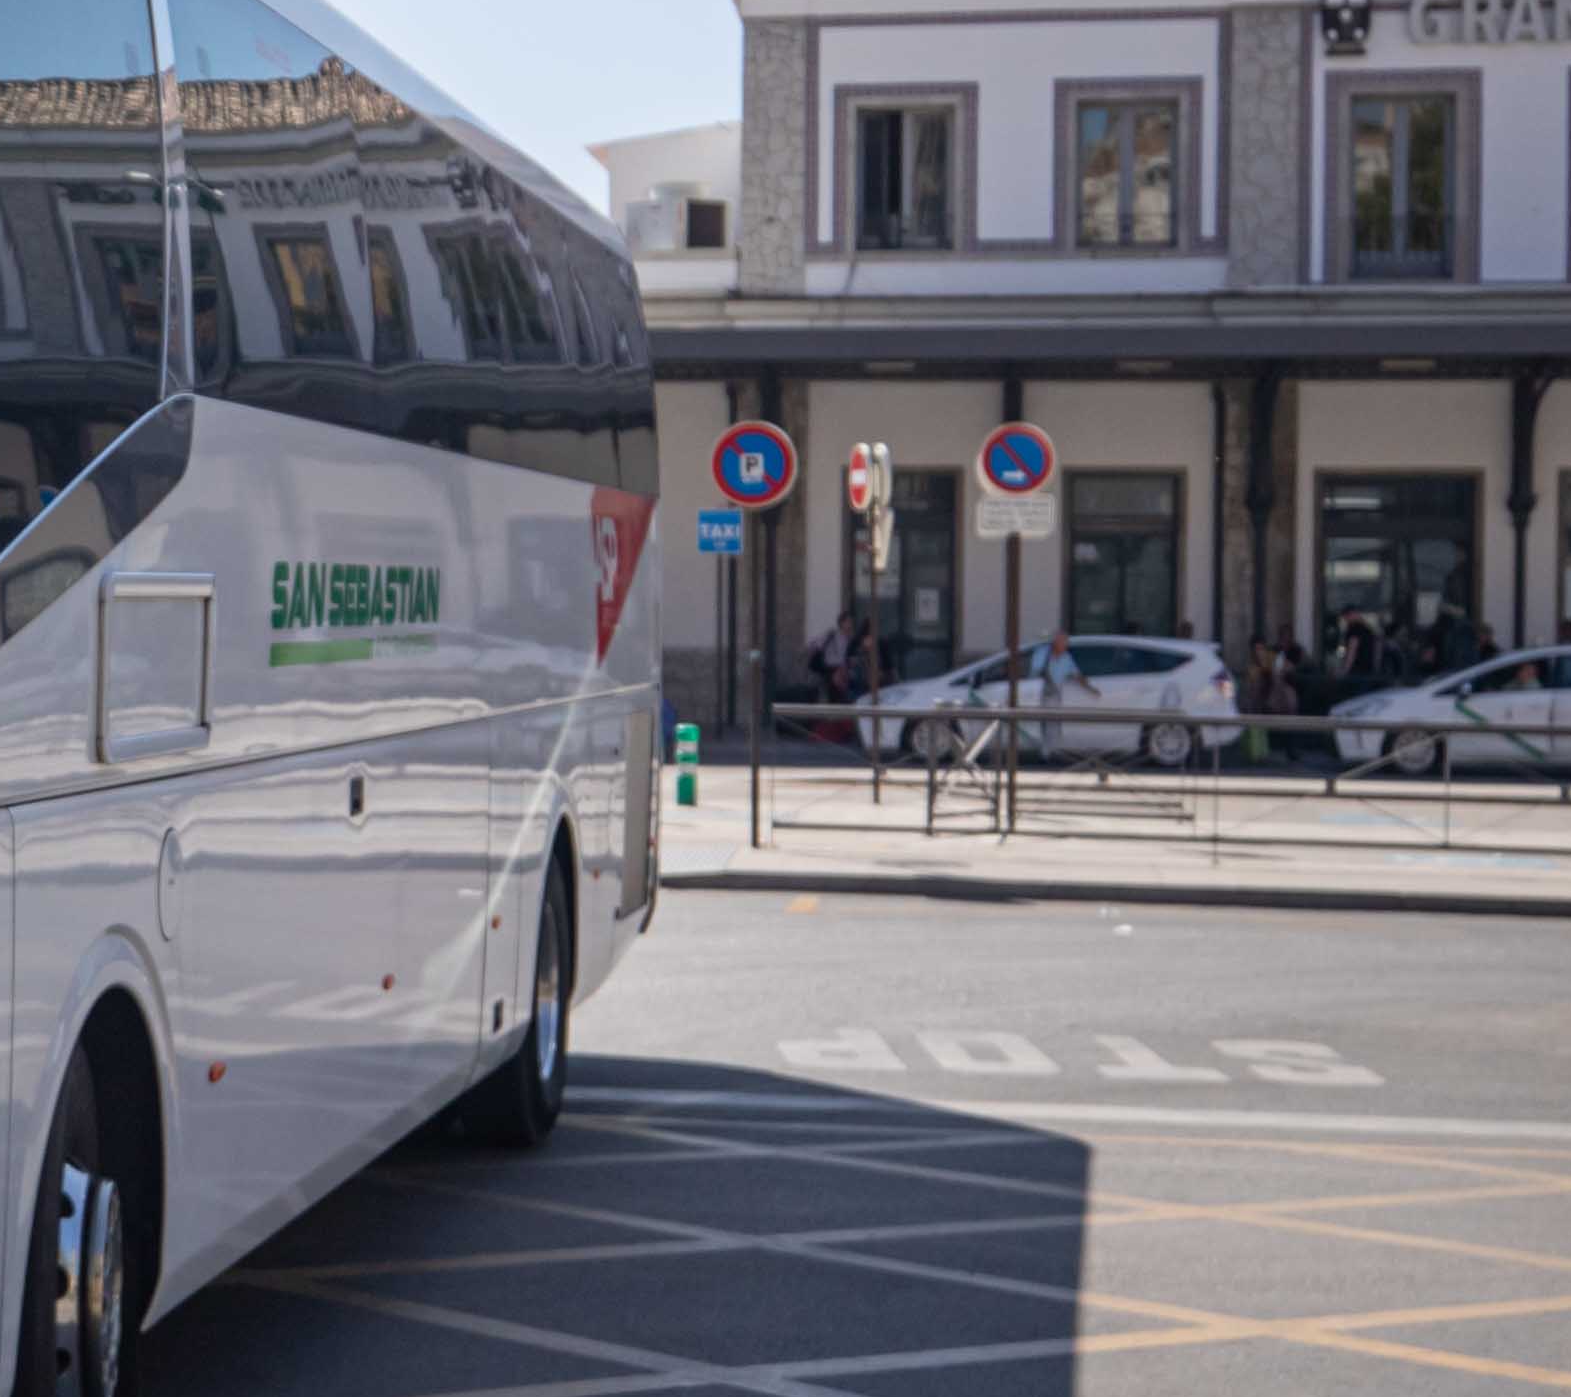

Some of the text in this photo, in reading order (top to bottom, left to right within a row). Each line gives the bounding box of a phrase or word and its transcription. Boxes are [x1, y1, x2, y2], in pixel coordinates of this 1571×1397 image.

[700, 522, 741, 540] TAXI
[269, 560, 441, 630] SAN SEBASTIAN
[776, 1027, 1386, 1087] STOP
